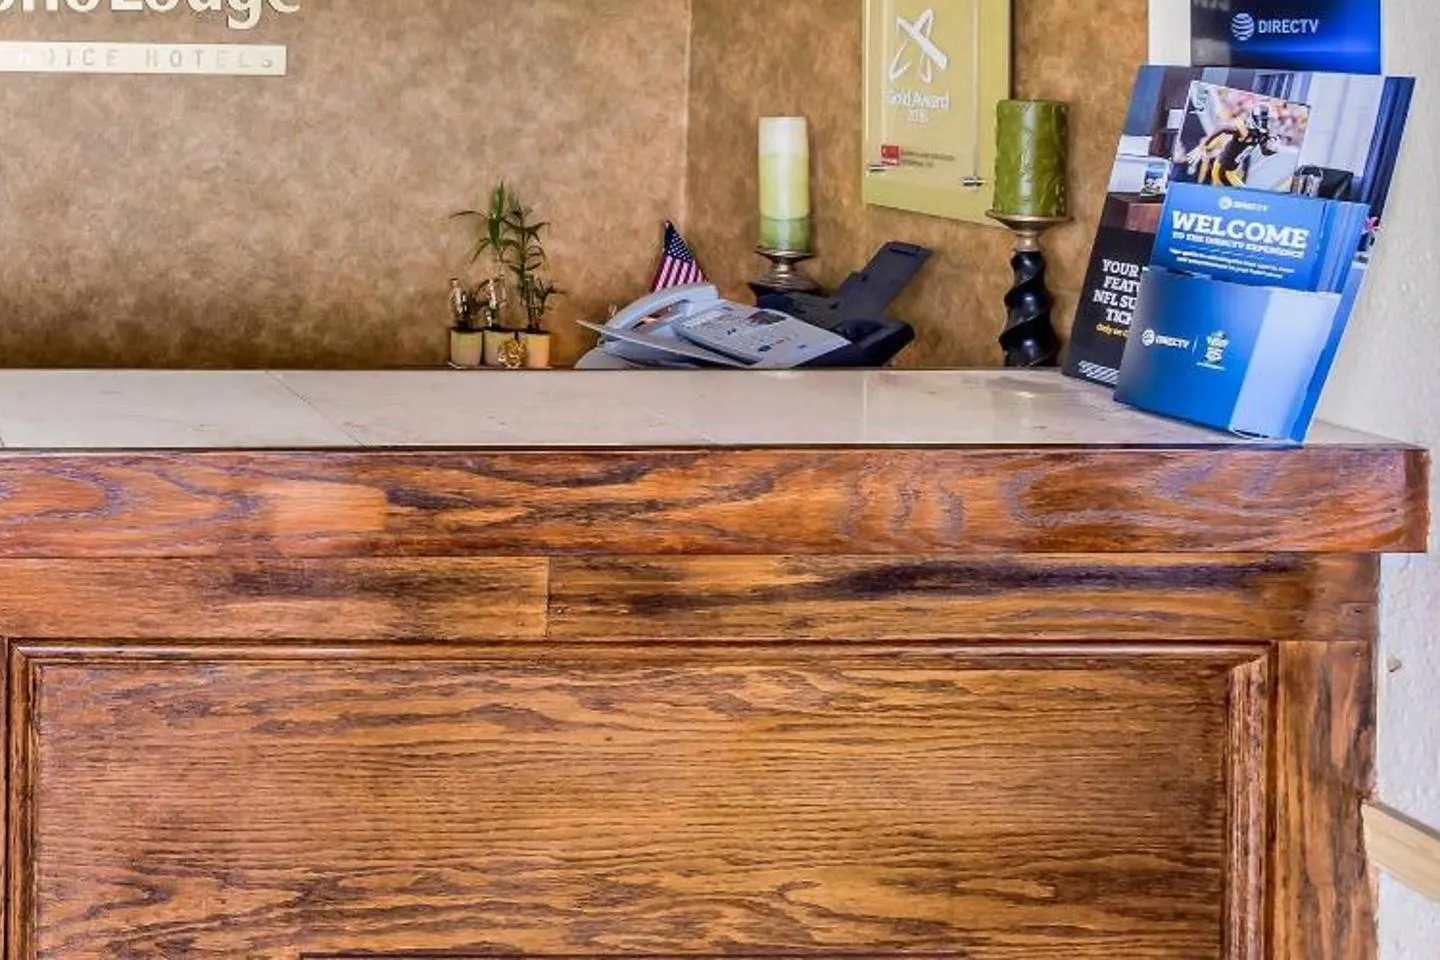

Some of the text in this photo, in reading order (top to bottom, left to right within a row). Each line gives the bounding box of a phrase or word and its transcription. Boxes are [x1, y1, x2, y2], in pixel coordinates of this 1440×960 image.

[1258, 18, 1319, 34] DIRECTV
[1172, 210, 1310, 249] WELCOME
[1102, 259, 1139, 277] YOUR
[1092, 289, 1118, 306] NFL
